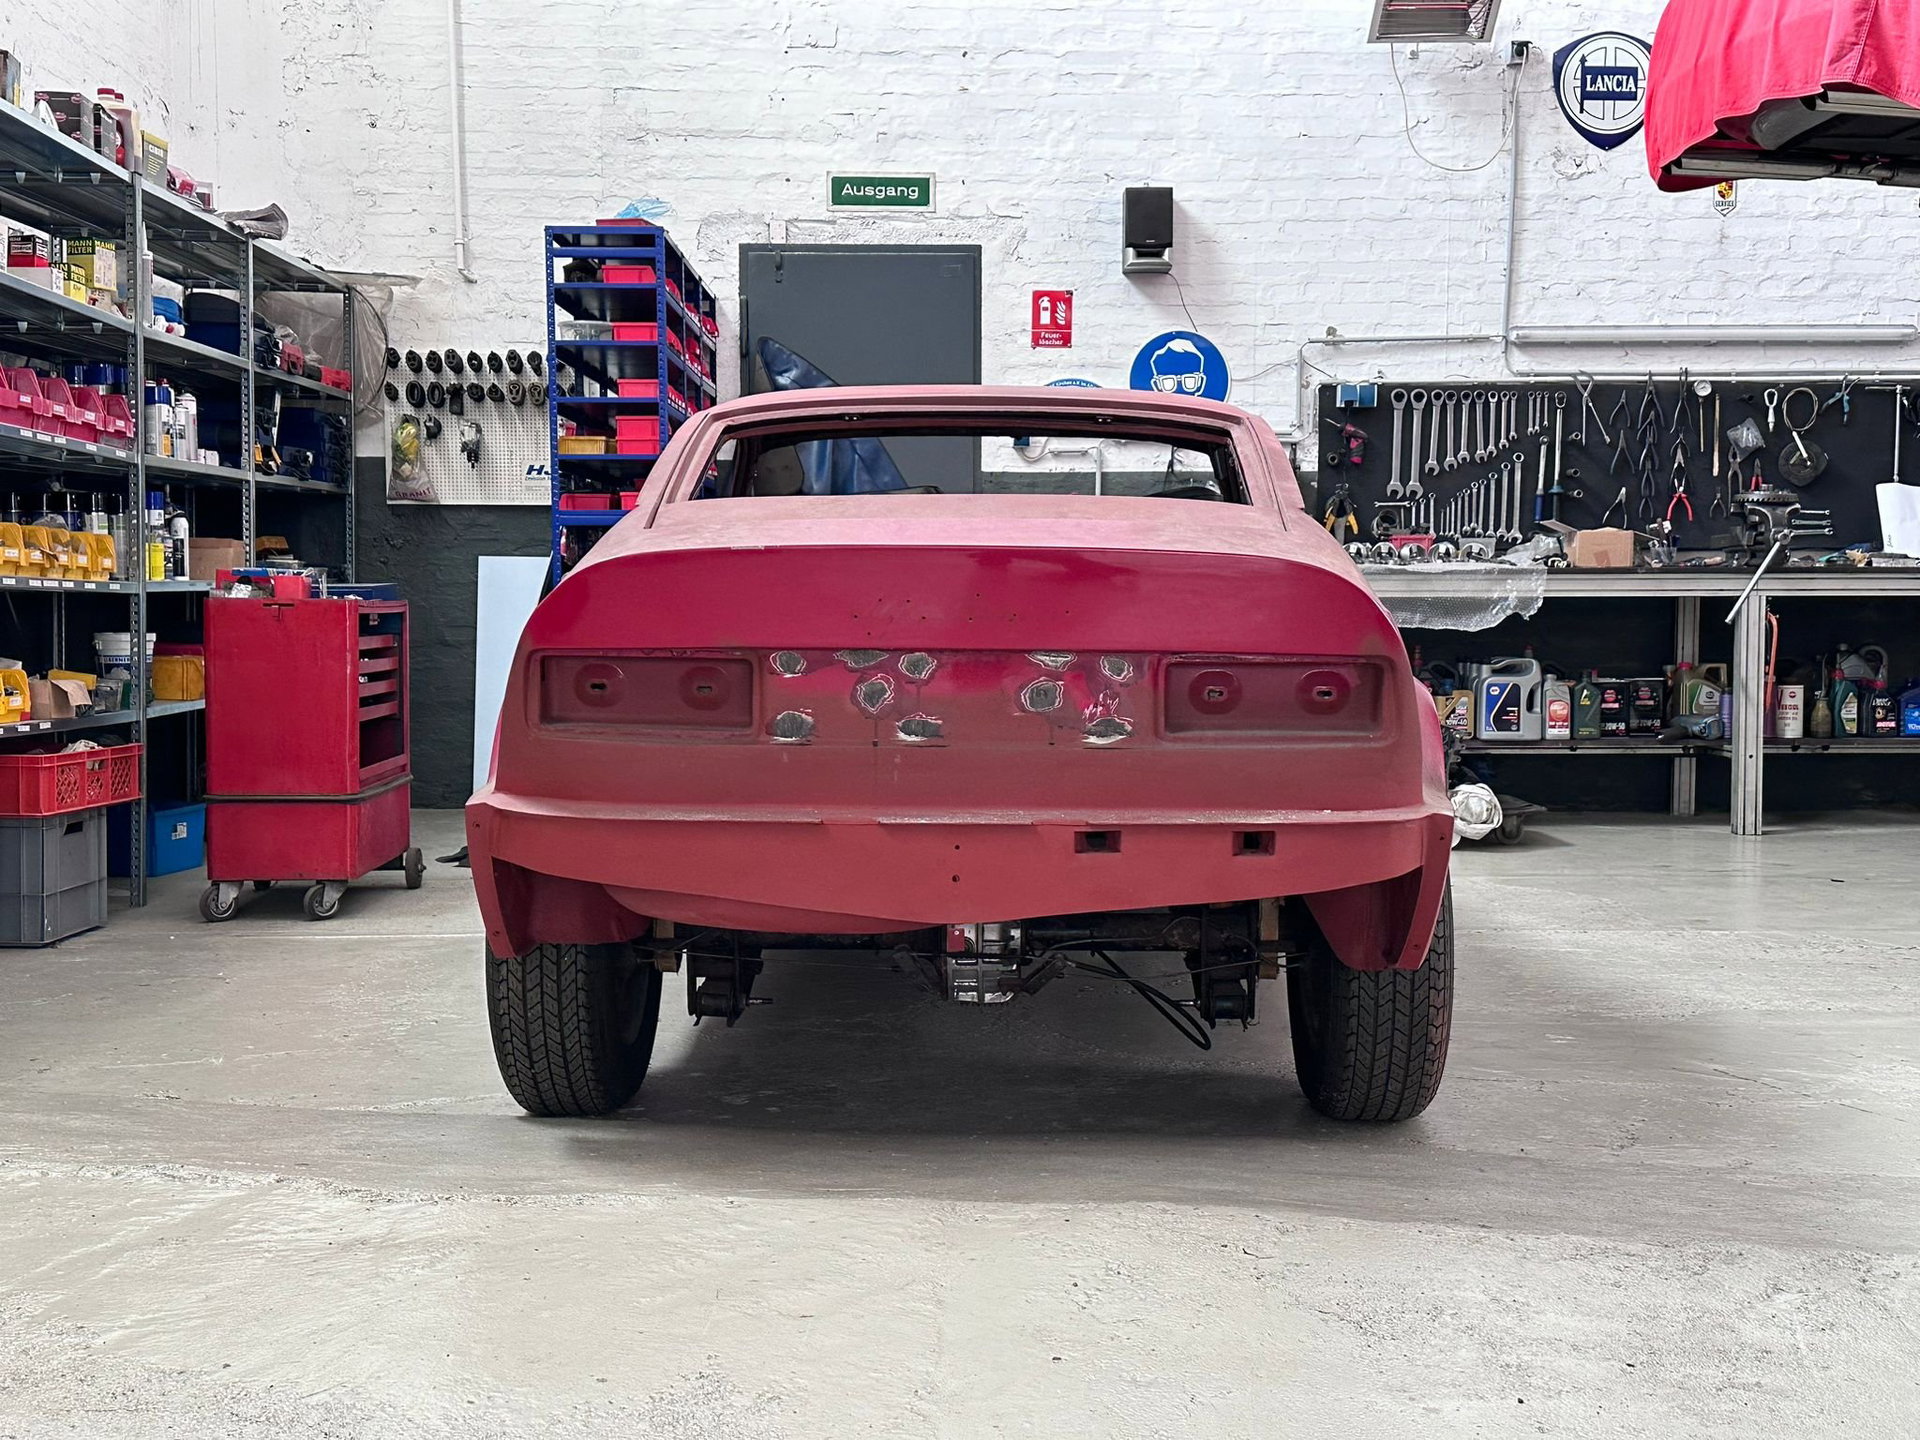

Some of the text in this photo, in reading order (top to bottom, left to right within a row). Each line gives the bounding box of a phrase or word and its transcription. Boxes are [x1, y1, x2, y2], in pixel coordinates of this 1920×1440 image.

[1585, 74, 1637, 92] LANCIA
[841, 183, 919, 199] Ausgang
[67, 239, 93, 247] MANN
[67, 246, 93, 254] FILTER
